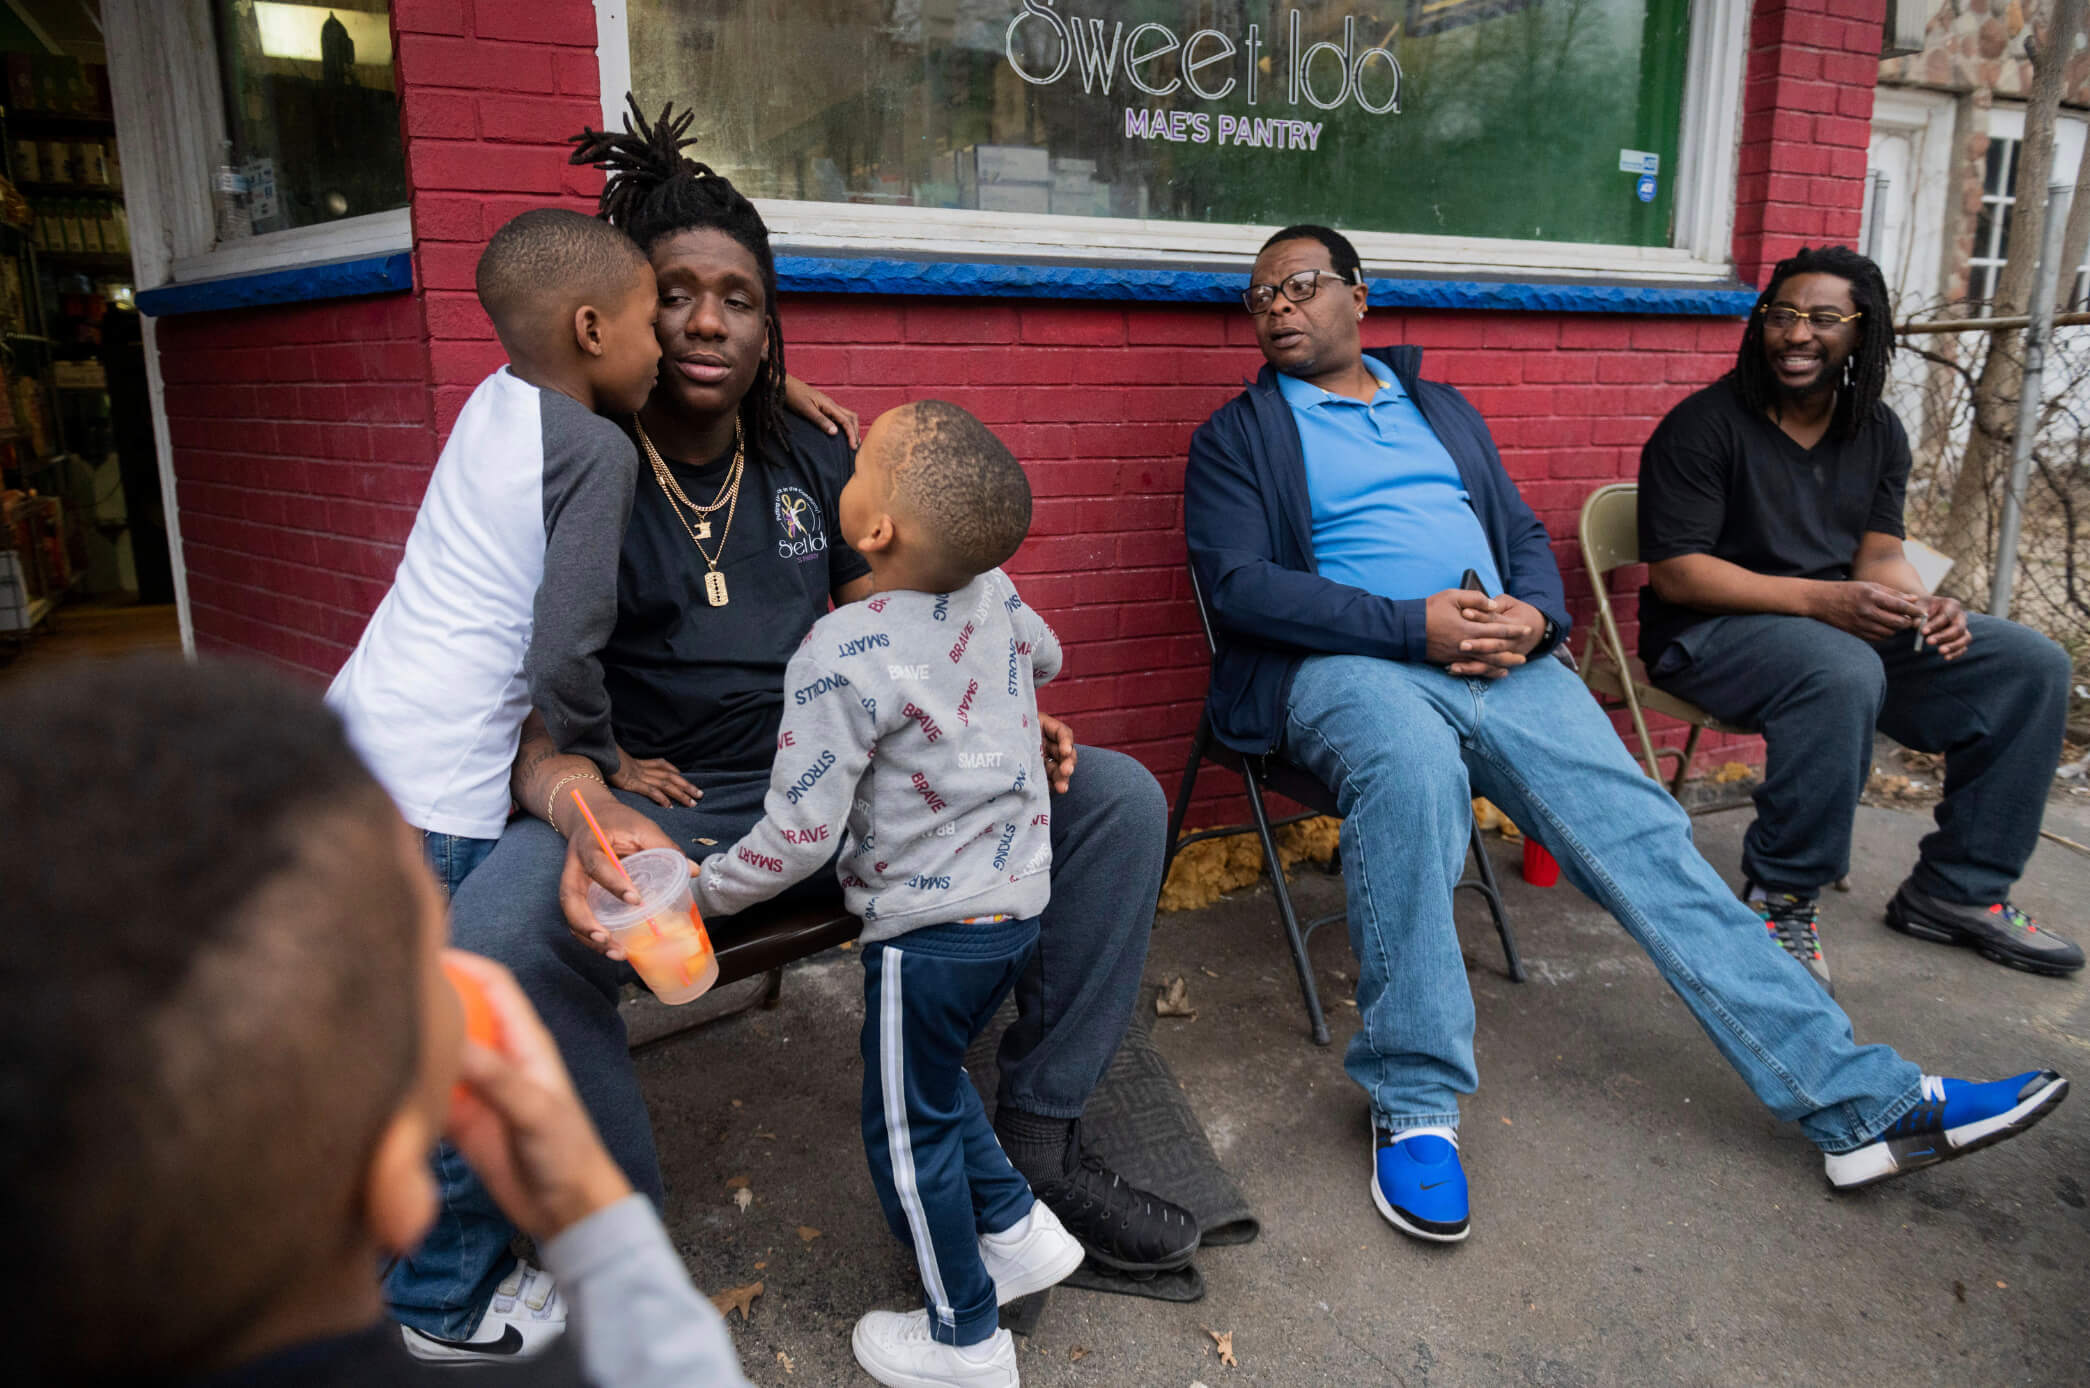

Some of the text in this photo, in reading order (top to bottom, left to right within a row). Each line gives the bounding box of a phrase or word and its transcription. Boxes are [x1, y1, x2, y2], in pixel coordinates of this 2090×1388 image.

[1006, 0, 1401, 114] Sweet Ida
[1125, 107, 1323, 150] MAE'S PANTRY
[838, 633, 890, 658] SMART
[949, 620, 975, 664] BRAVE
[786, 750, 836, 805] STRONG
[958, 752, 1003, 769] SMART
[911, 772, 947, 813] BRAVE
